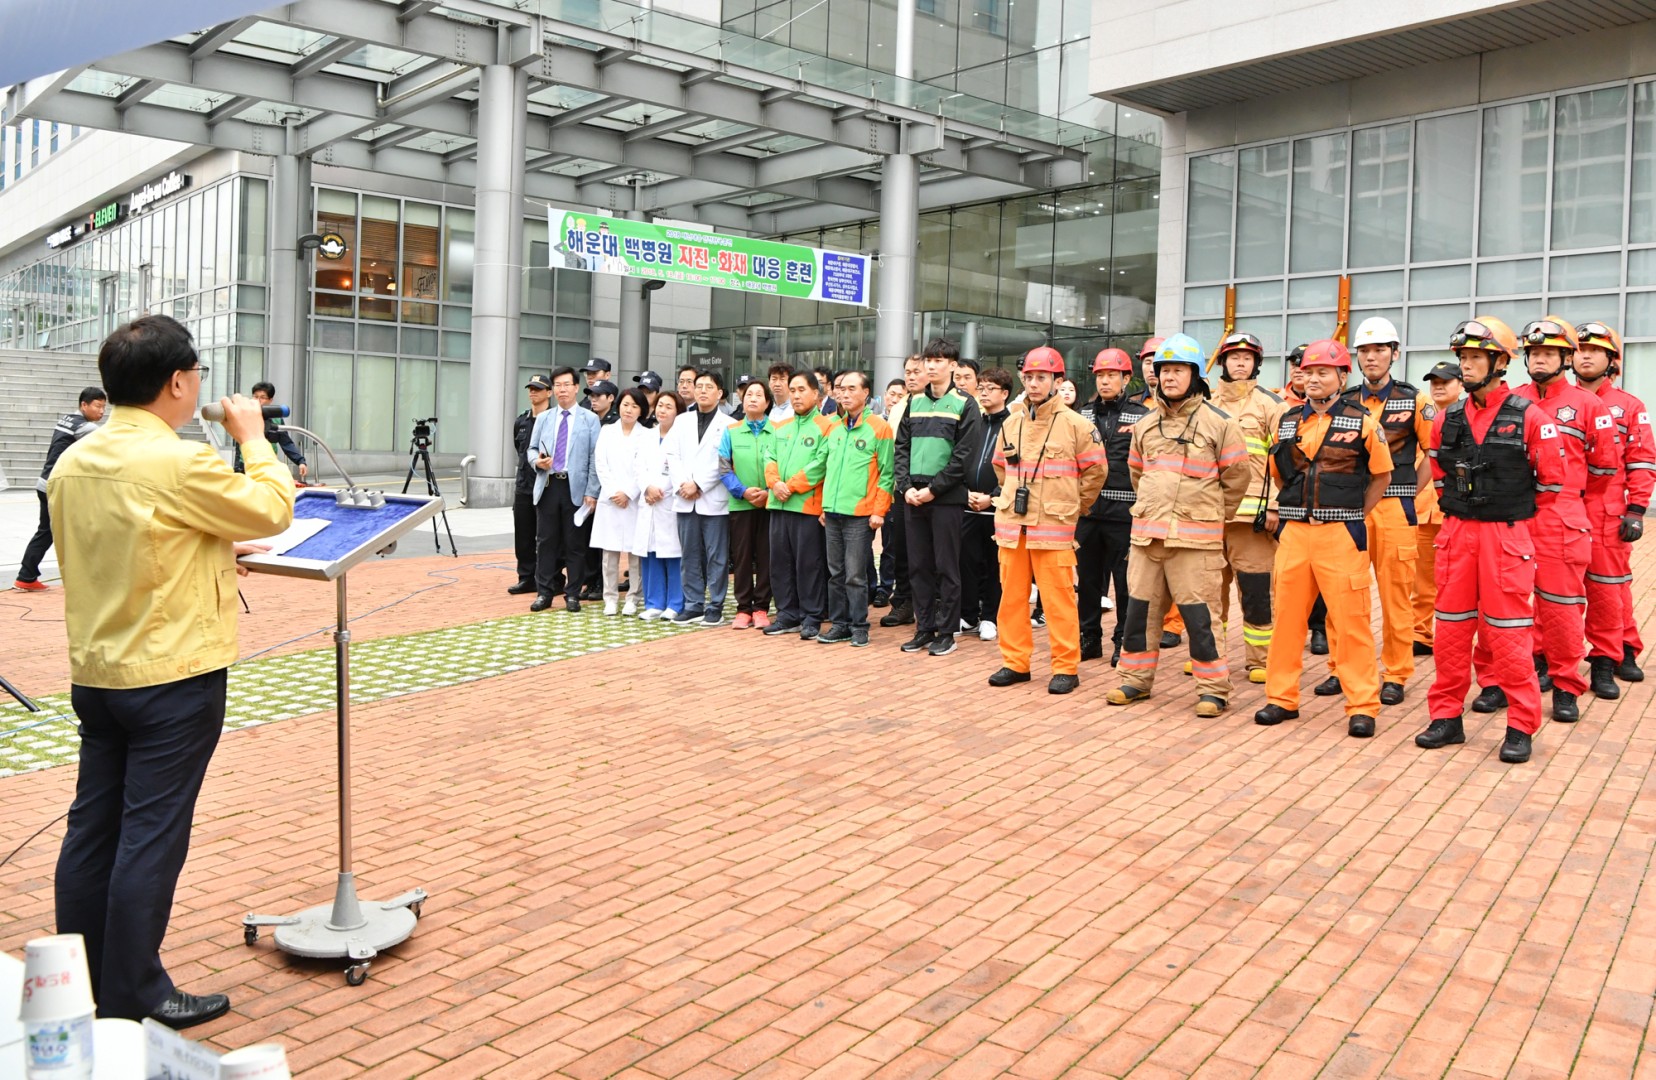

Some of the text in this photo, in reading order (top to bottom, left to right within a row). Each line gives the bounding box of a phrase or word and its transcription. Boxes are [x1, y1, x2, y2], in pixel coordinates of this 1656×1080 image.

[567, 229, 618, 257] 해운대
[624, 237, 672, 265] 백병원
[753, 256, 780, 280] 대응
[786, 260, 812, 284] 훈련
[700, 356, 722, 365] West Gate
[1386, 411, 1412, 423] 119
[1498, 423, 1517, 433] 119
[1330, 431, 1359, 443] 119
